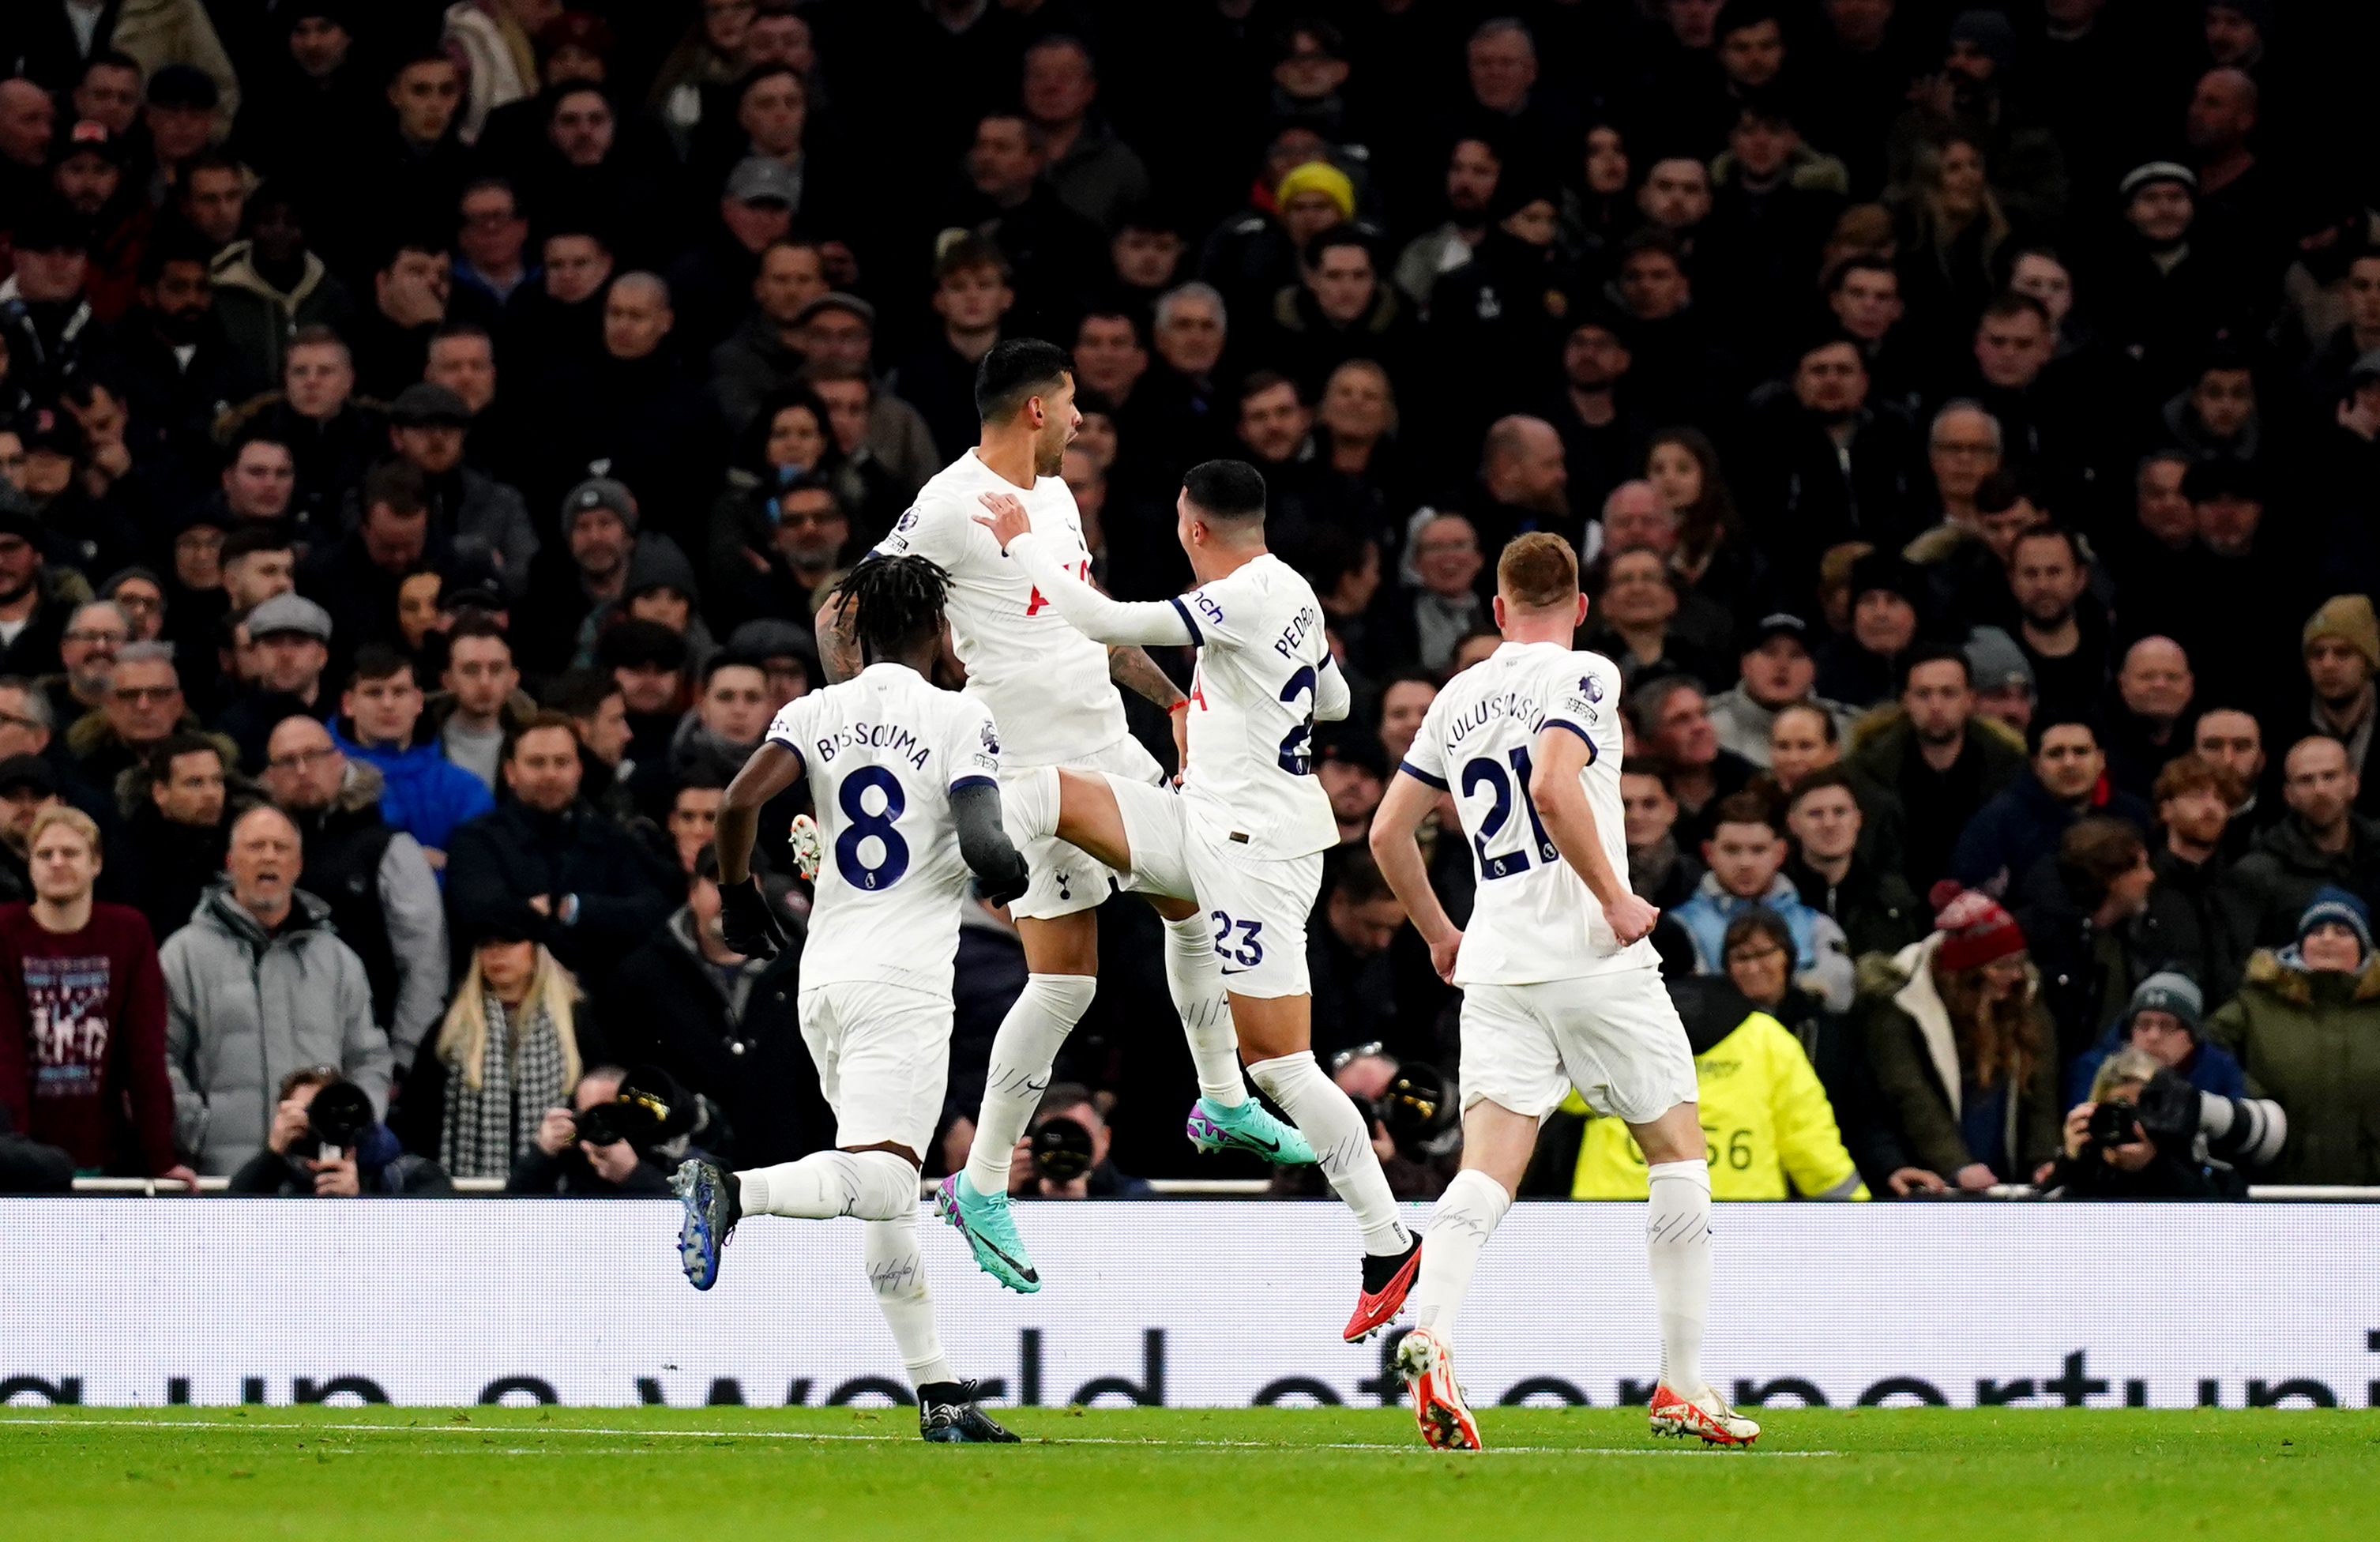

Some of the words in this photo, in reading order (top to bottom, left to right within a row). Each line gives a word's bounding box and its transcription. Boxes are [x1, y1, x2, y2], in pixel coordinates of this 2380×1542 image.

[817, 722, 931, 771] BISSOUMA
[835, 765, 910, 891] 8
[1461, 744, 1559, 881] 21
[1211, 910, 1262, 967] 23
